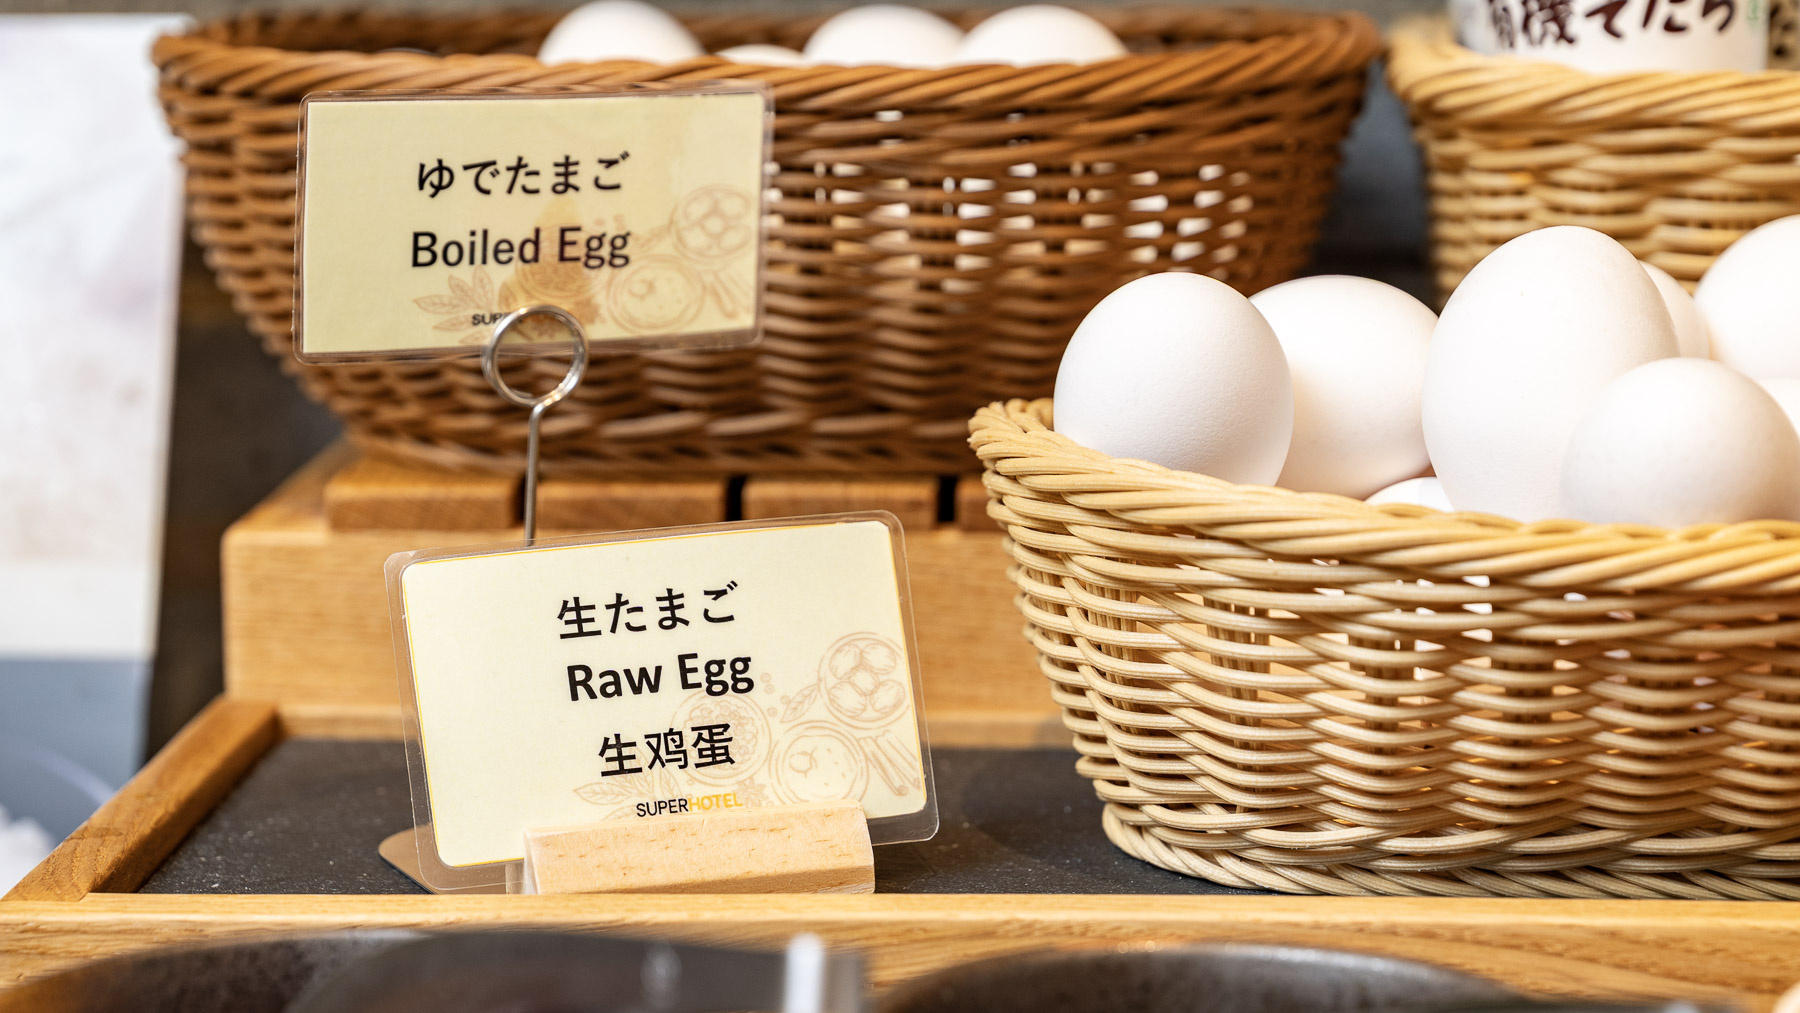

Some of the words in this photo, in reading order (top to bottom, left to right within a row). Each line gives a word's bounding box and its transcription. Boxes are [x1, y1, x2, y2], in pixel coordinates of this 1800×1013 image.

[418, 151, 630, 198] ゆでたまご
[412, 227, 541, 268] Boiled
[558, 226, 631, 269] Egg
[557, 580, 739, 639] 生たまご
[567, 664, 663, 701] Raw
[678, 653, 755, 696] Egg
[599, 723, 736, 777] 生鸡蛋
